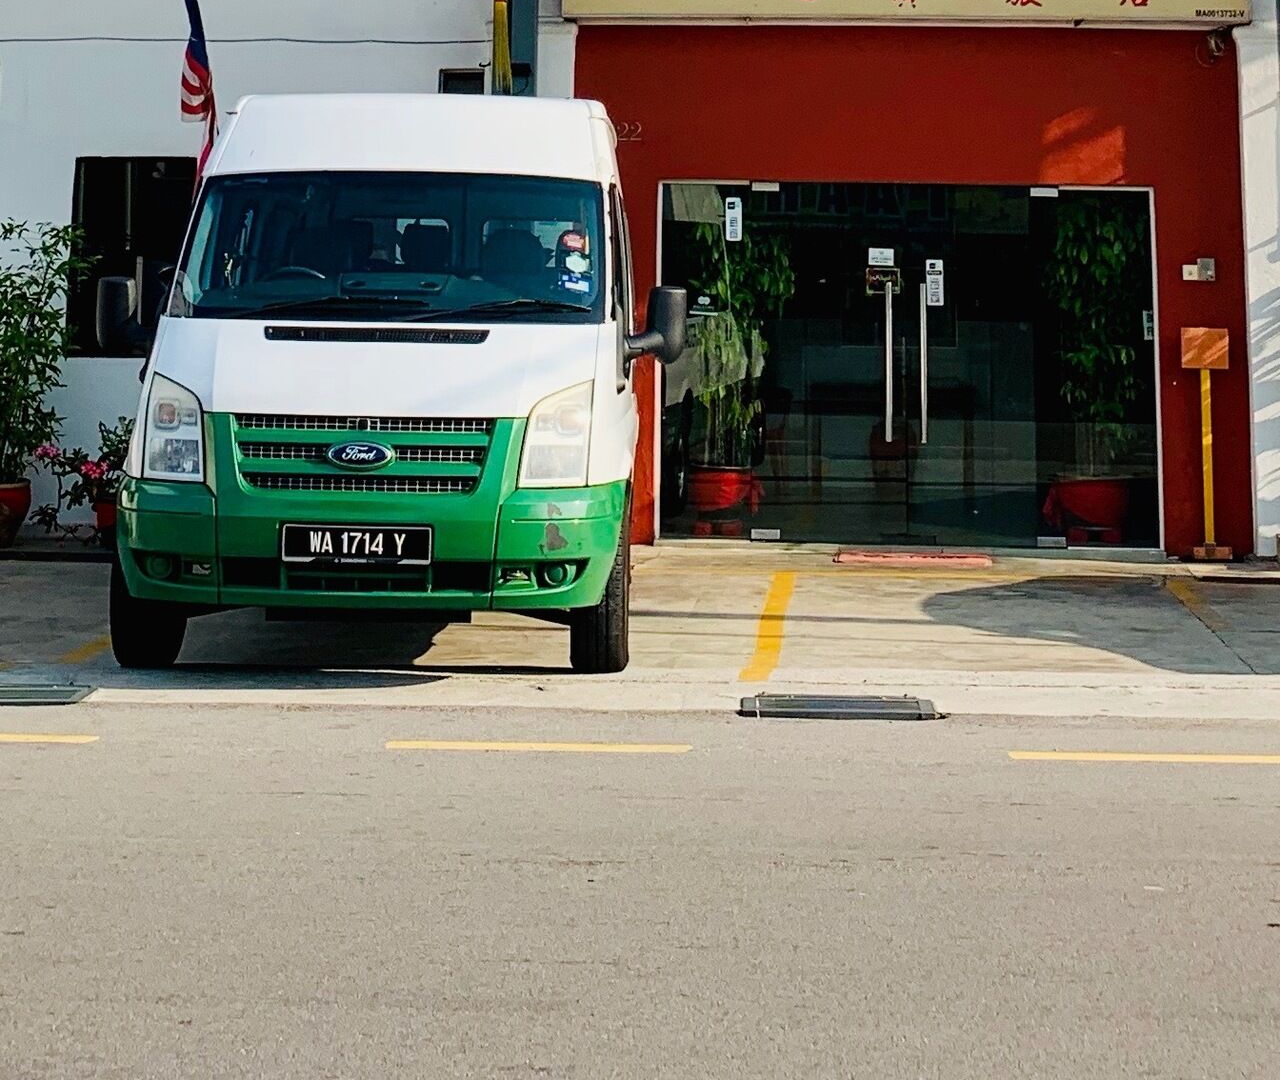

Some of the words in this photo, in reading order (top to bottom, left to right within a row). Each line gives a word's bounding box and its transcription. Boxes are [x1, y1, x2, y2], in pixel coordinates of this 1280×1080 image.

[341, 445, 377, 461] Ford
[309, 531, 334, 554] WA
[340, 531, 384, 555] 1714
[393, 532, 407, 556] Y
